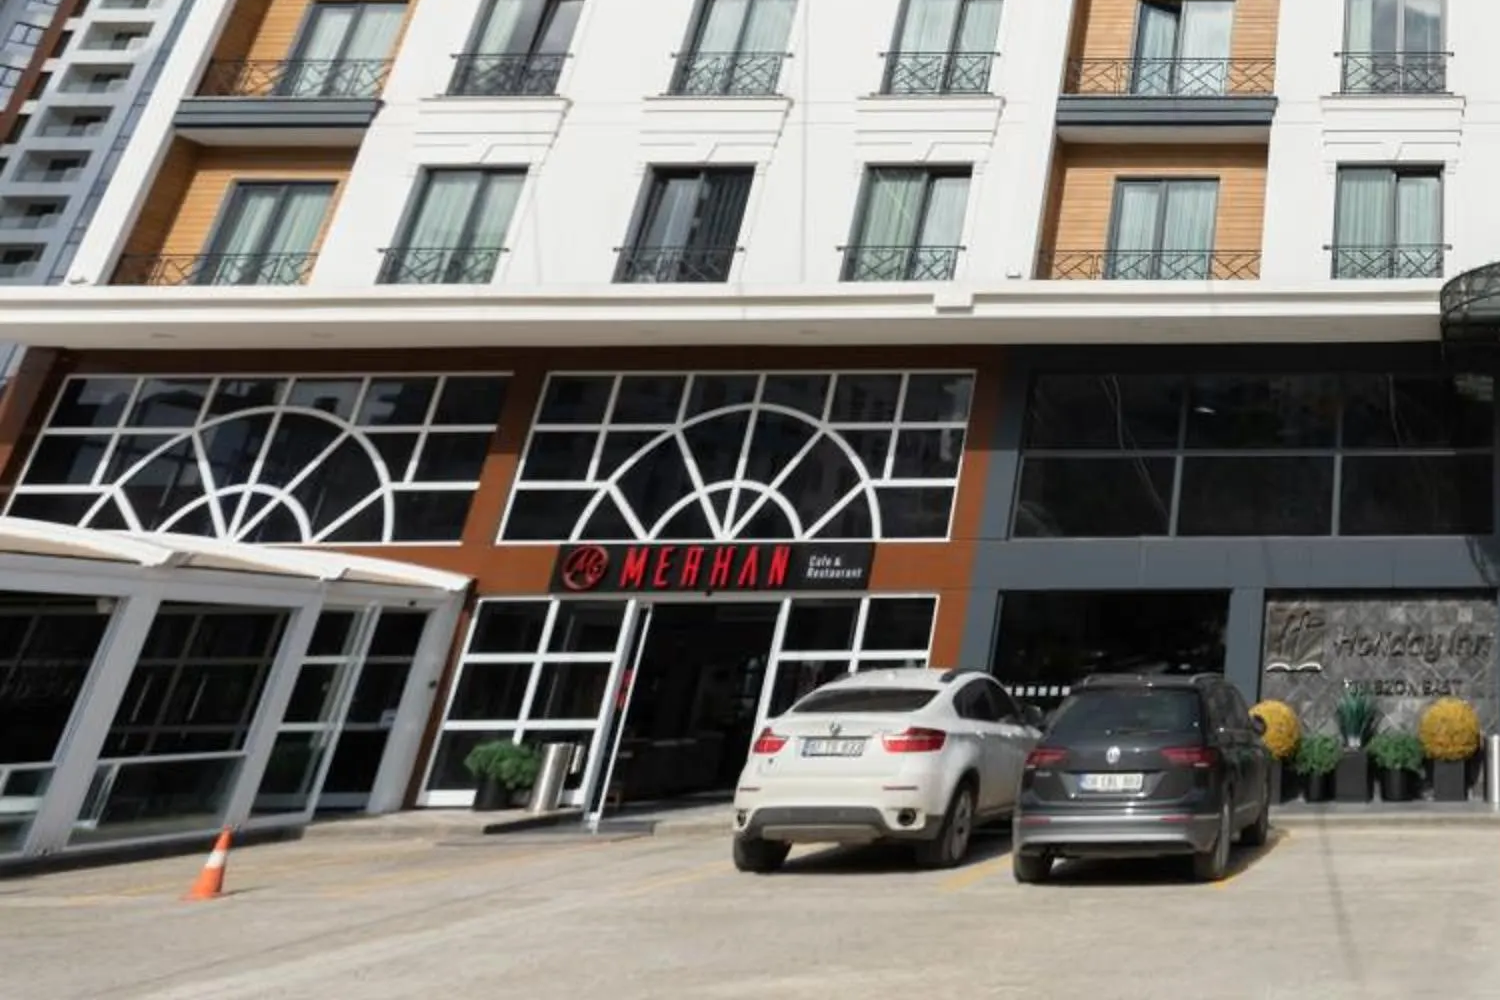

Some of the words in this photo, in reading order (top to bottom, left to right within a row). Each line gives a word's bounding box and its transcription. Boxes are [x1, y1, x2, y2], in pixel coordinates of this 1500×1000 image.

[619, 546, 791, 588] MERHAN
[806, 567, 862, 578] Restaurant
[1334, 624, 1443, 663] Holiday
